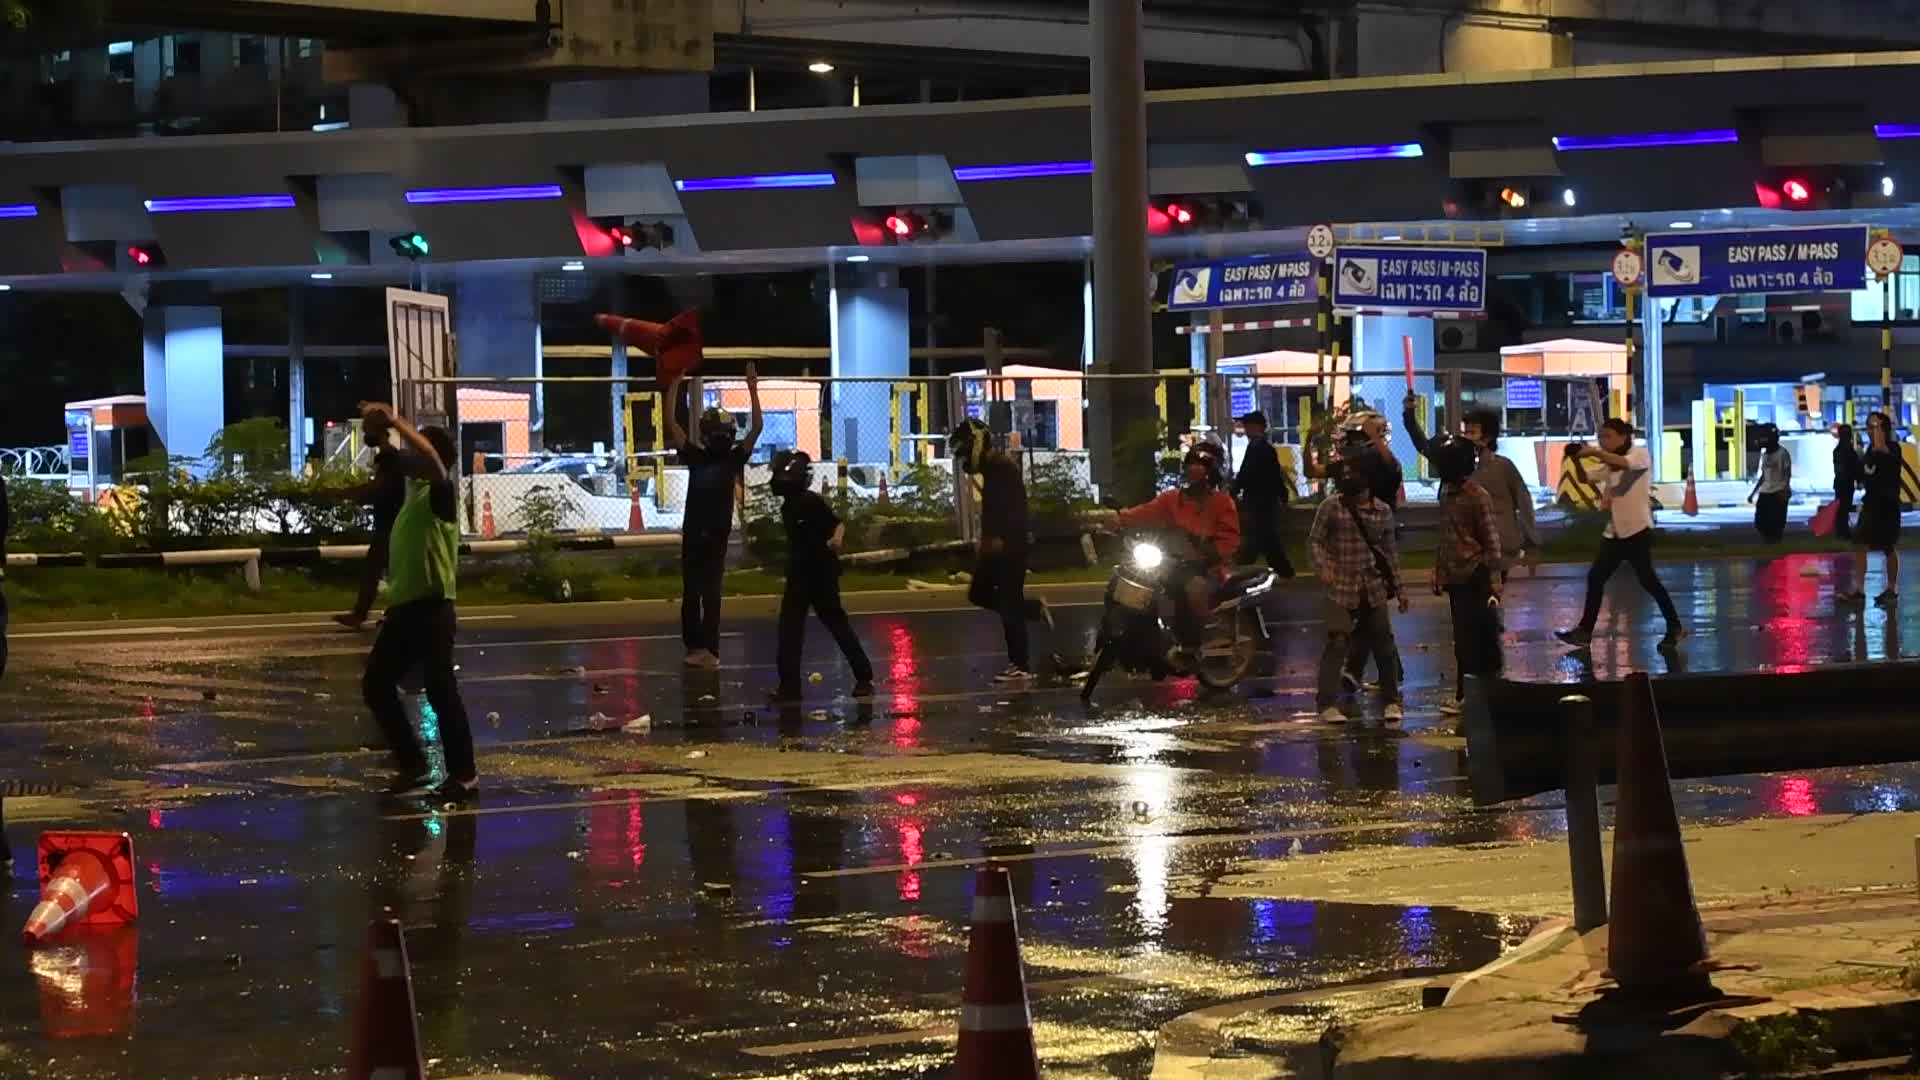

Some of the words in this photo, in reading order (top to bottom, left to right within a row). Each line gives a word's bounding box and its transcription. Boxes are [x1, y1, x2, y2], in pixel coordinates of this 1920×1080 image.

[1728, 246, 1756, 263] EASY
[1758, 244, 1786, 262] PASS
[1224, 267, 1248, 283] EASY
[1248, 264, 1271, 281] PASS
[1381, 259, 1408, 277] EASY
[1730, 271, 1795, 288] เฉพาะรถ
[1799, 272, 1809, 286] 4
[1813, 266, 1834, 286] ล้อ
[1219, 286, 1272, 302] เฉพาะรถ
[1276, 285, 1284, 298] 4
[1288, 279, 1305, 297] ล้อ
[1381, 283, 1441, 302] เฉพาะรถ
[1446, 284, 1456, 301] 4
[1458, 280, 1479, 303] ล้อ
